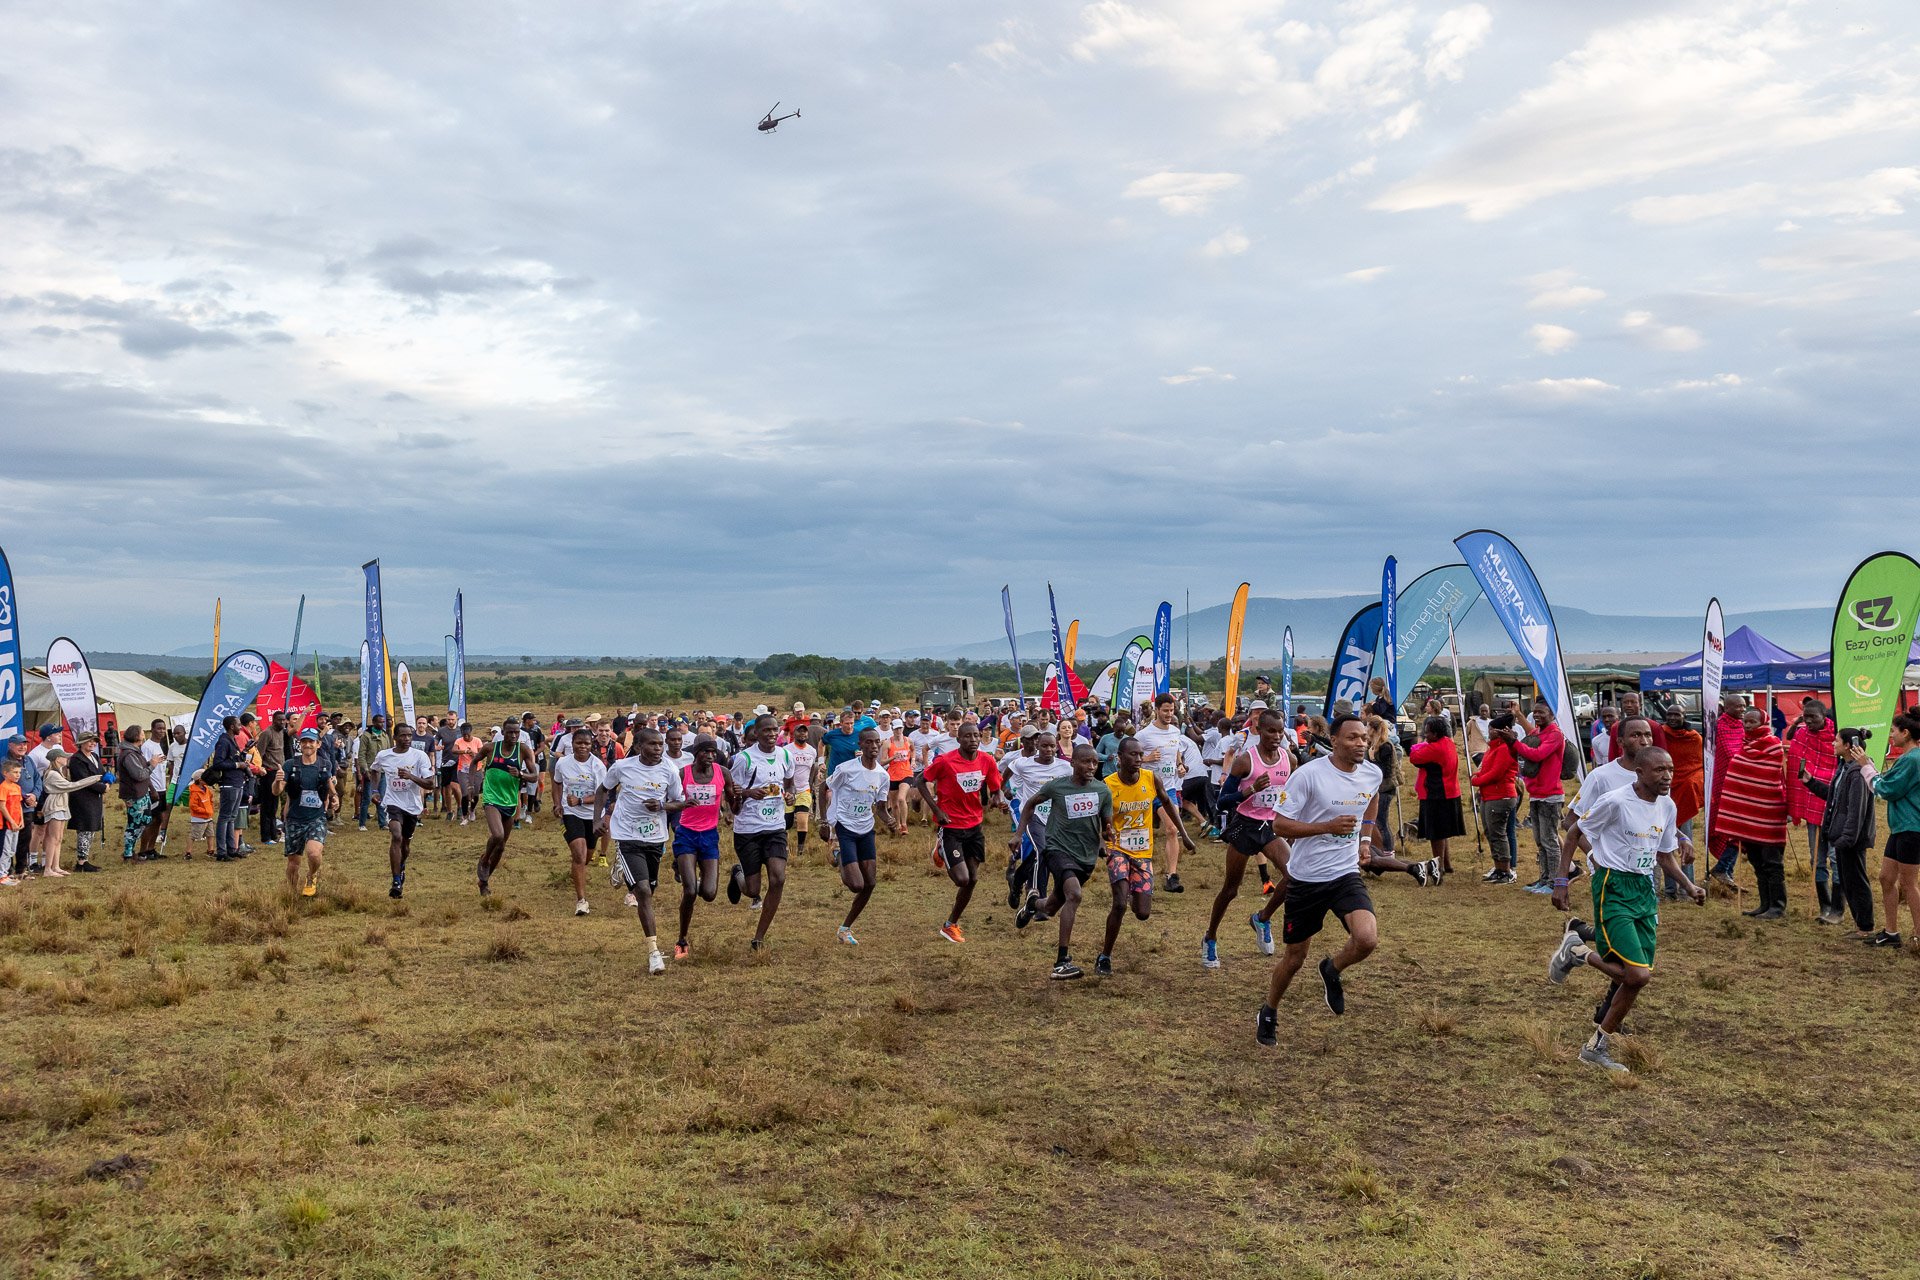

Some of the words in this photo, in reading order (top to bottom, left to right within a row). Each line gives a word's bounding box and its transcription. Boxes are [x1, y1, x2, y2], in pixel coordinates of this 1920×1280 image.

[1433, 588, 1464, 623] Credit
[1397, 580, 1455, 655] Momentum
[1856, 596, 1894, 631] EZ
[1845, 640, 1870, 651] Eezy
[233, 658, 264, 673] Mara
[192, 694, 240, 745] MARA
[962, 778, 978, 787] 082
[692, 792, 710, 800] 123
[1261, 793, 1278, 802] 121
[1072, 801, 1094, 812] 039
[1122, 813, 1145, 829] 24
[637, 823, 655, 834] 120
[1127, 836, 1145, 846] 118
